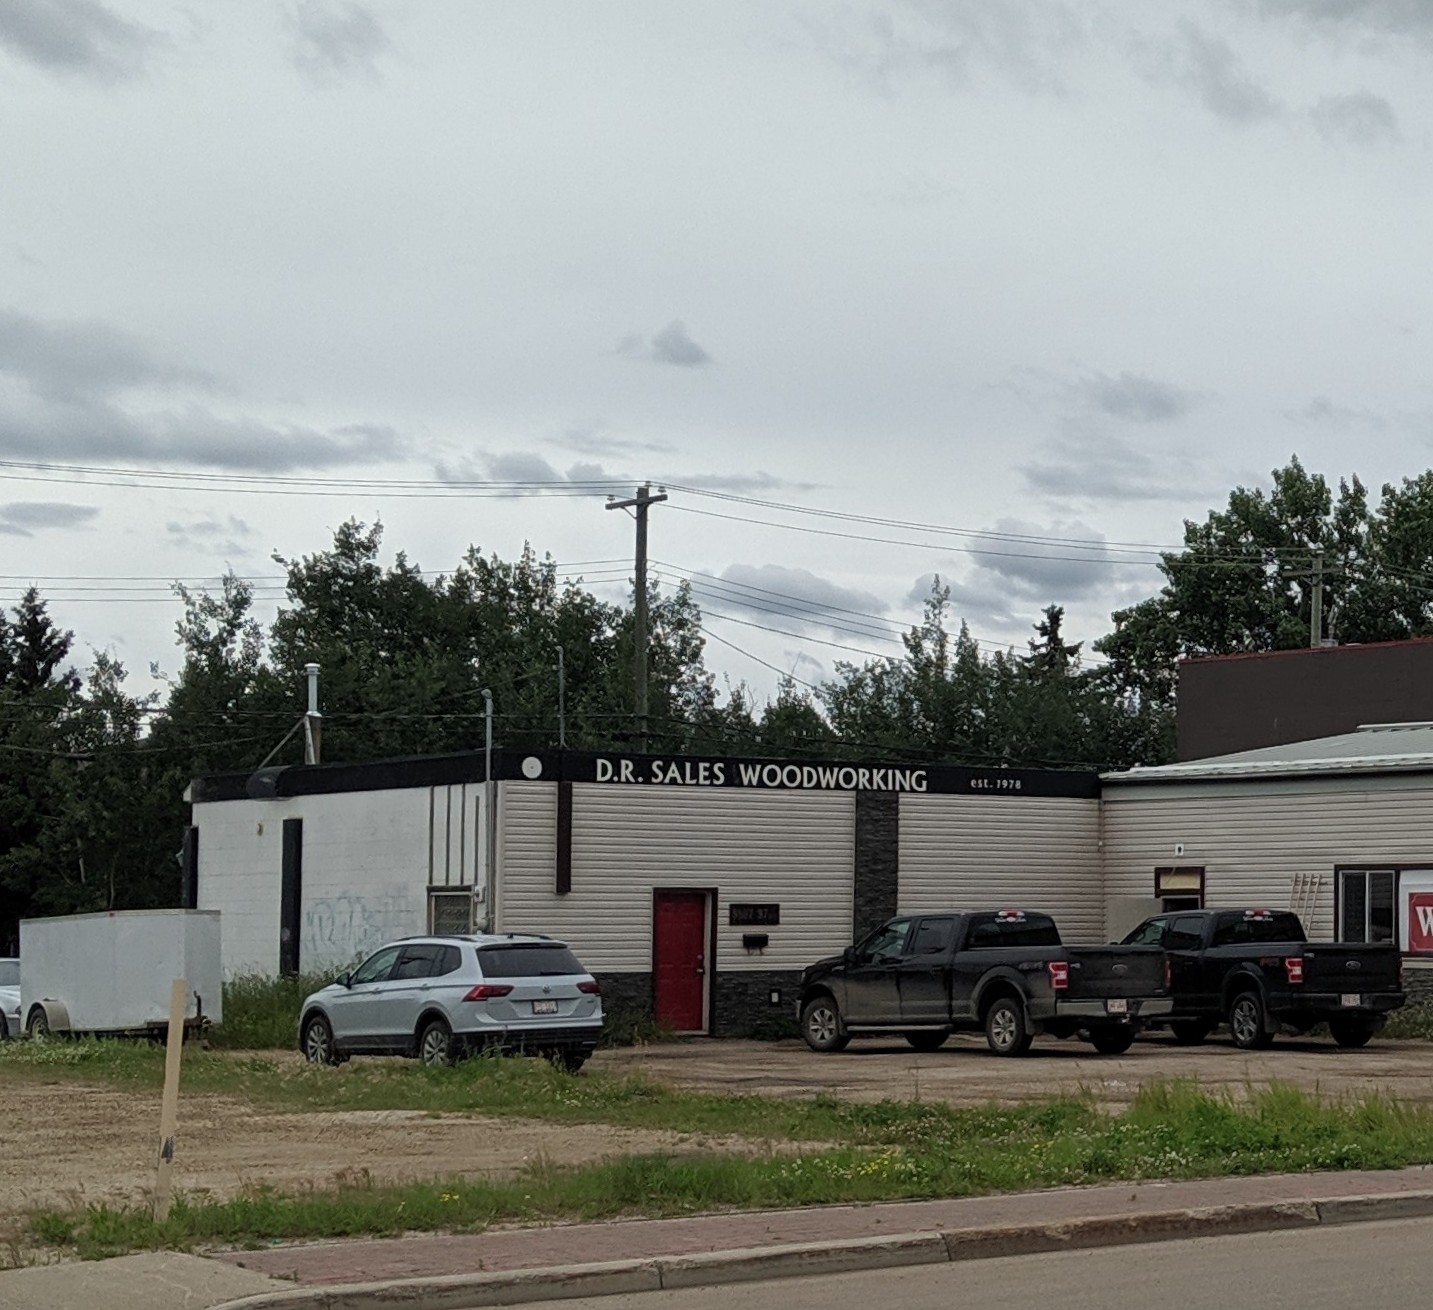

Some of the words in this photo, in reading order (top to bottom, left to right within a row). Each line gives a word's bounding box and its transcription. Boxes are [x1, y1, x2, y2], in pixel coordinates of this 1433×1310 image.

[596, 758, 643, 782] D.R.
[651, 760, 725, 785] SALES
[739, 763, 928, 792] WOODWORKING
[970, 778, 993, 788] est.
[996, 779, 1021, 790] 1978
